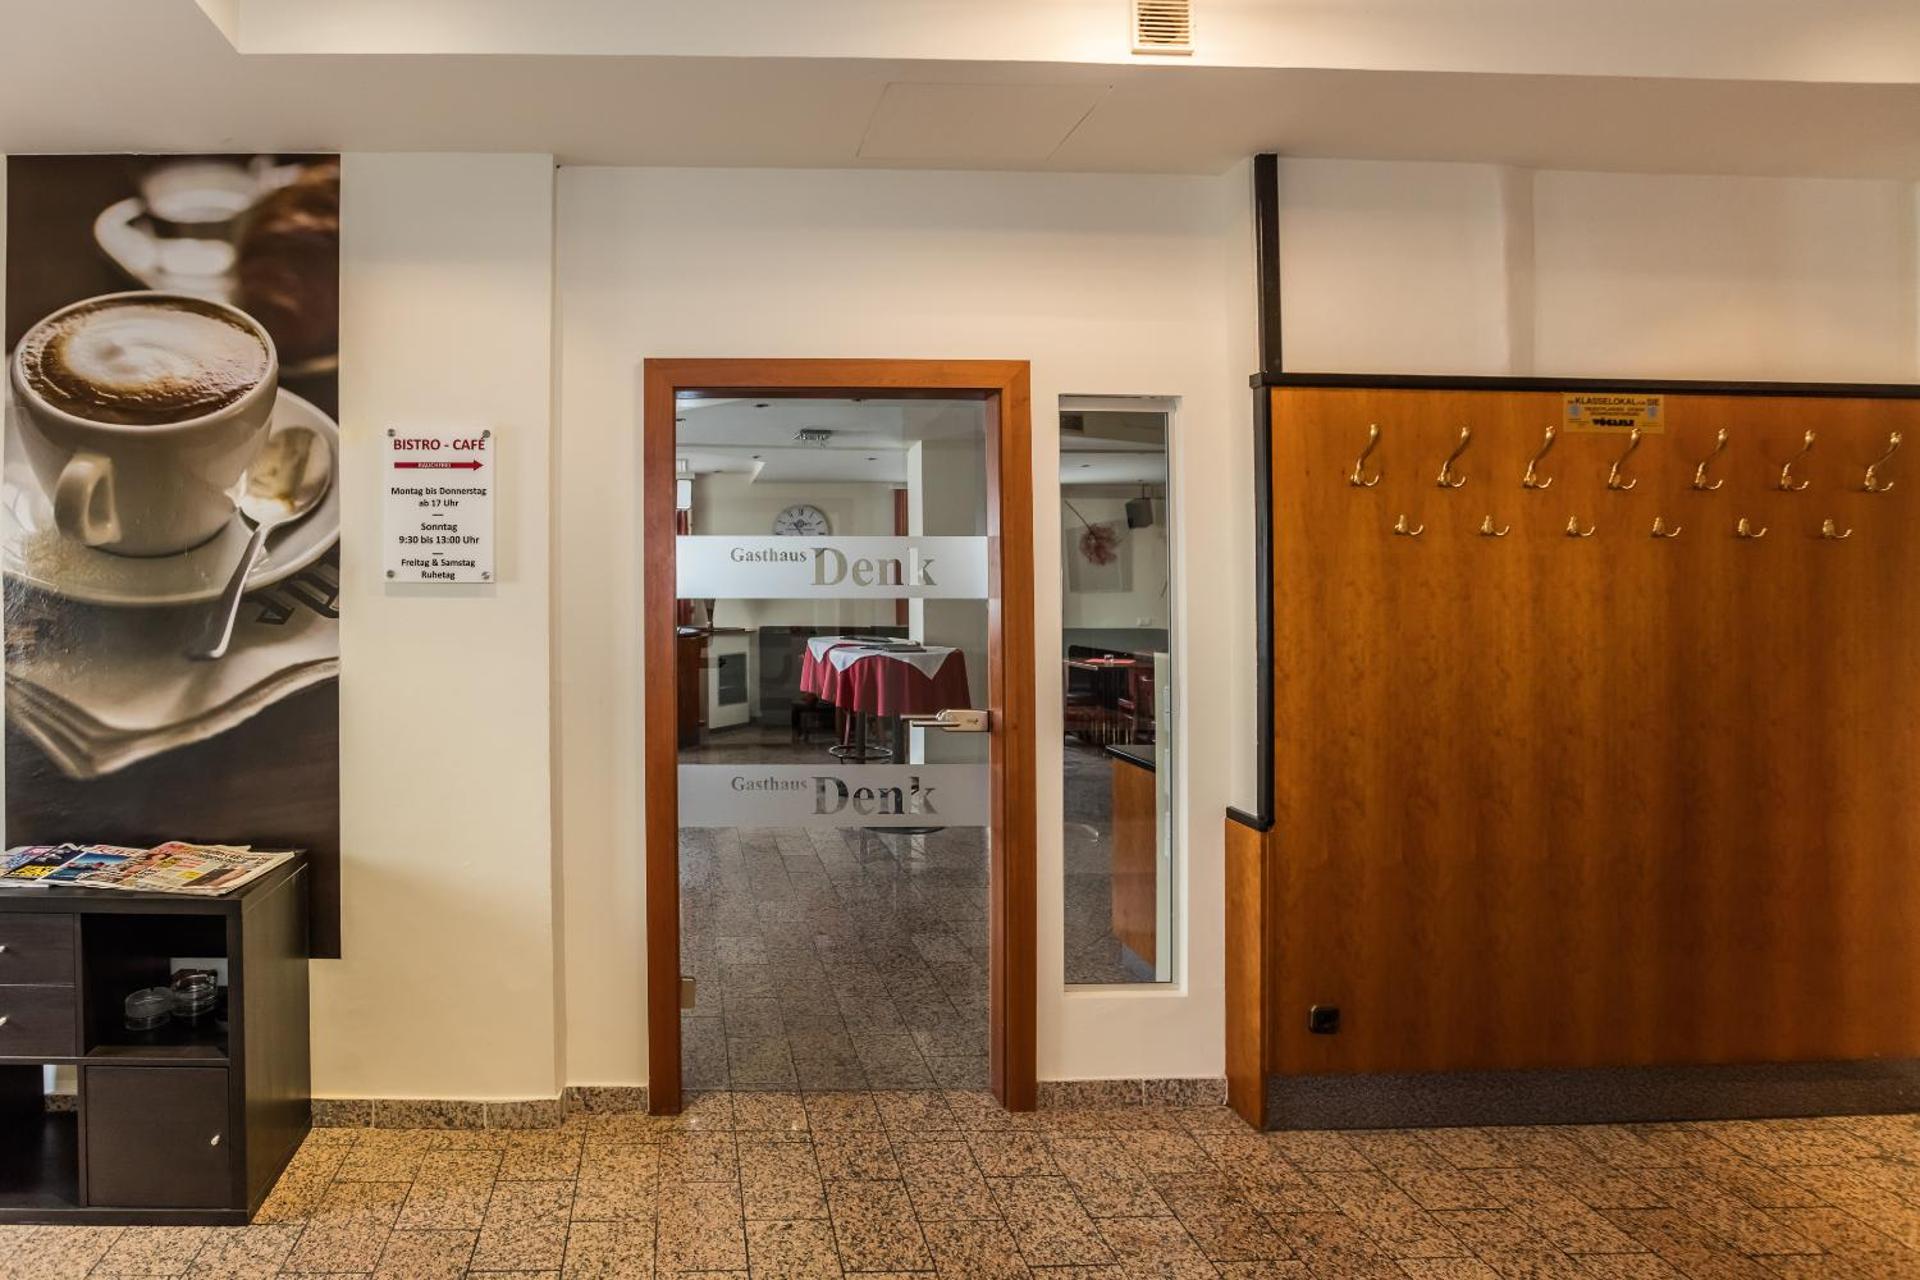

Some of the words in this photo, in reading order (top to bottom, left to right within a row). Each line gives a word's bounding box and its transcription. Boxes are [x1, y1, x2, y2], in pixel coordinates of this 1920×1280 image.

[394, 439, 440, 450] BISTRO
[453, 436, 486, 450] CAFÉ
[391, 487, 423, 496] Montag
[426, 487, 437, 495] bis
[440, 487, 487, 496] Donnerstag
[421, 523, 457, 532] Sonntag
[421, 536, 433, 544] bis
[401, 559, 429, 567] Freitag
[441, 559, 475, 567] Samstag
[730, 547, 807, 563] Gasthaus
[810, 547, 938, 586] Denk
[421, 572, 455, 580] Ruhetag
[731, 776, 807, 792] Gasthaus
[811, 776, 939, 815] Denk
